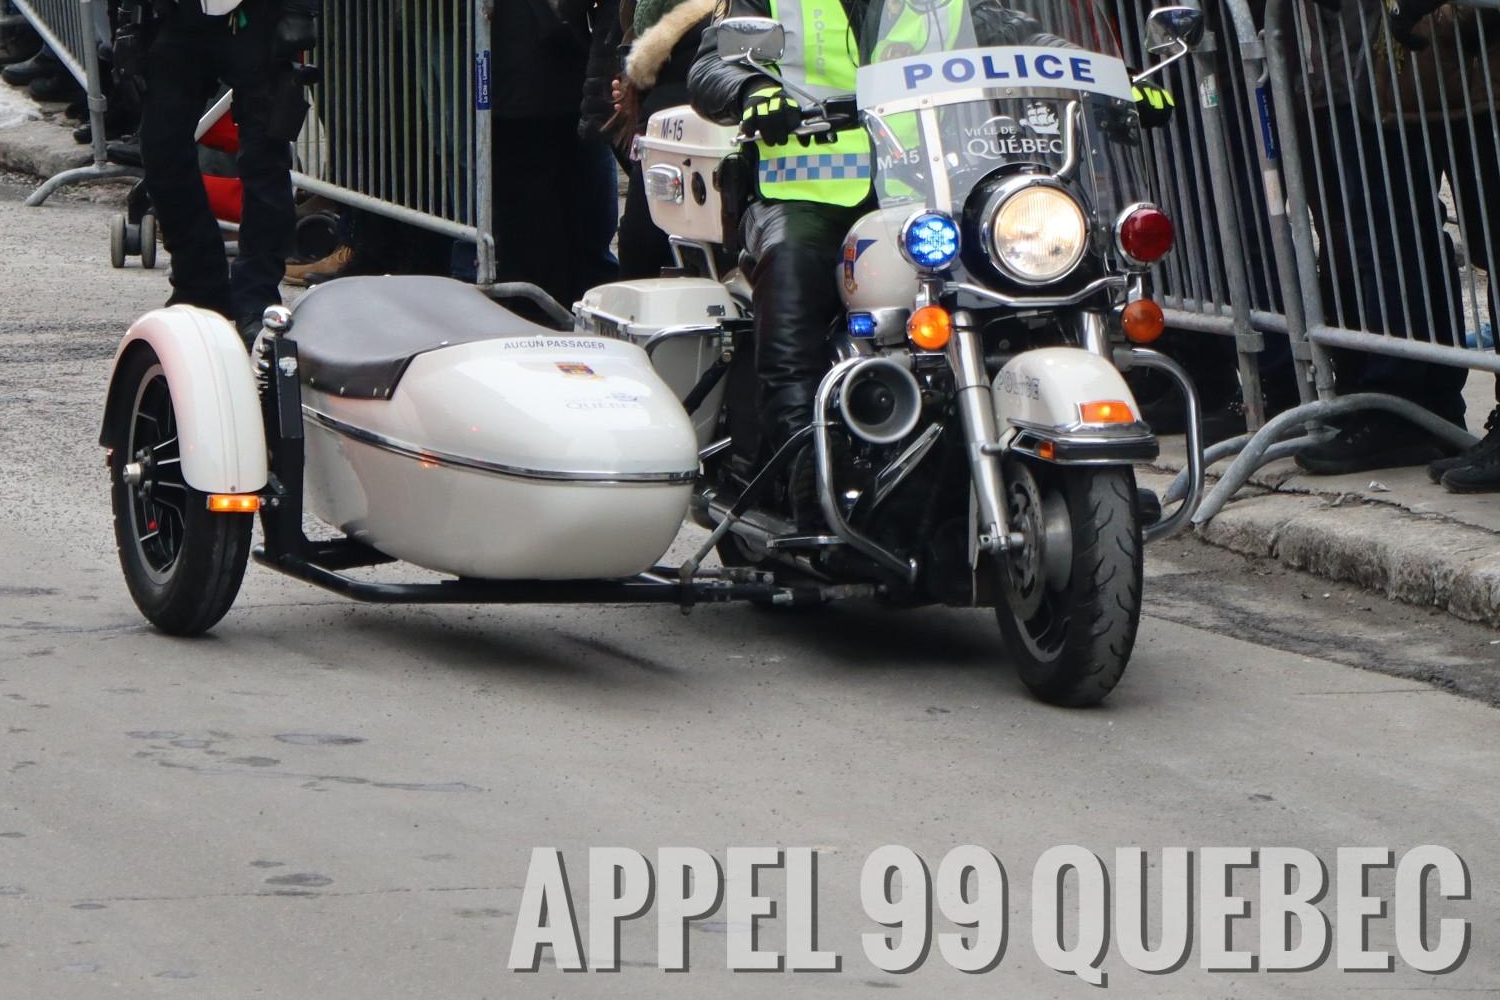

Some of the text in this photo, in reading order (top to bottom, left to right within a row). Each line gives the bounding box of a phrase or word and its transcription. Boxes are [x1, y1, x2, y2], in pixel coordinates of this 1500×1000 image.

[903, 54, 1095, 90] POLICE
[660, 118, 684, 141] M-15
[964, 125, 1016, 137] VILLE DE
[967, 135, 1064, 160] QUÉBEC
[877, 150, 920, 171] M-15
[504, 340, 606, 350] AUCUN PASSAGER
